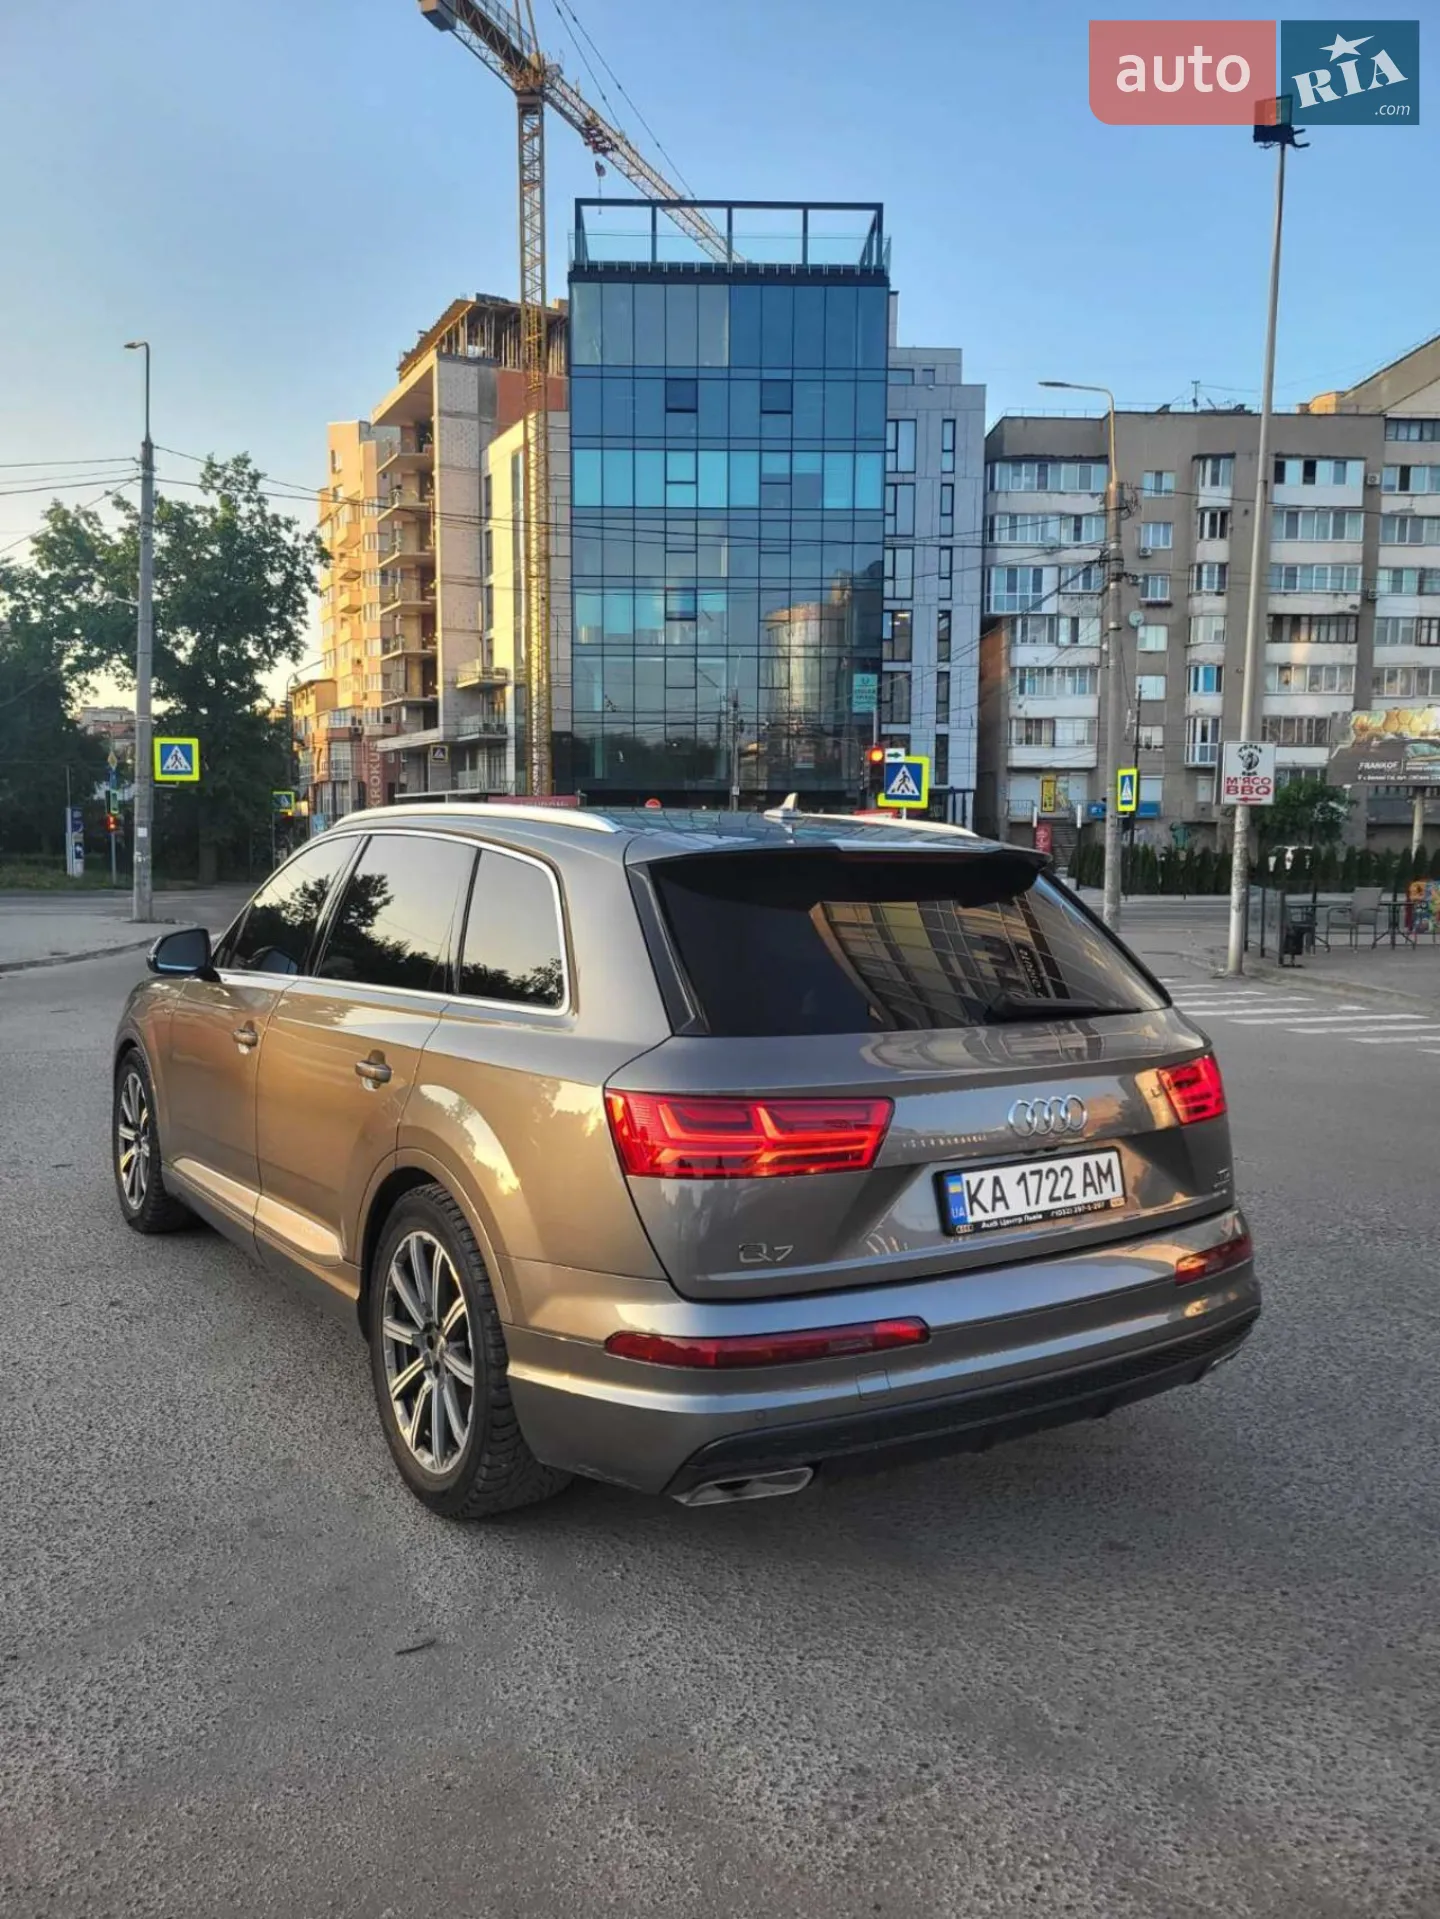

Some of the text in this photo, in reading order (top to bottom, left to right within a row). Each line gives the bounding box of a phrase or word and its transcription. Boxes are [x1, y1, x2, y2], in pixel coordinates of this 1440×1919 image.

[1226, 785, 1271, 795] BBQ
[965, 1158, 1116, 1216] KA 1722 AM
[951, 1207, 965, 1218] UA
[739, 1243, 794, 1263] Q7
